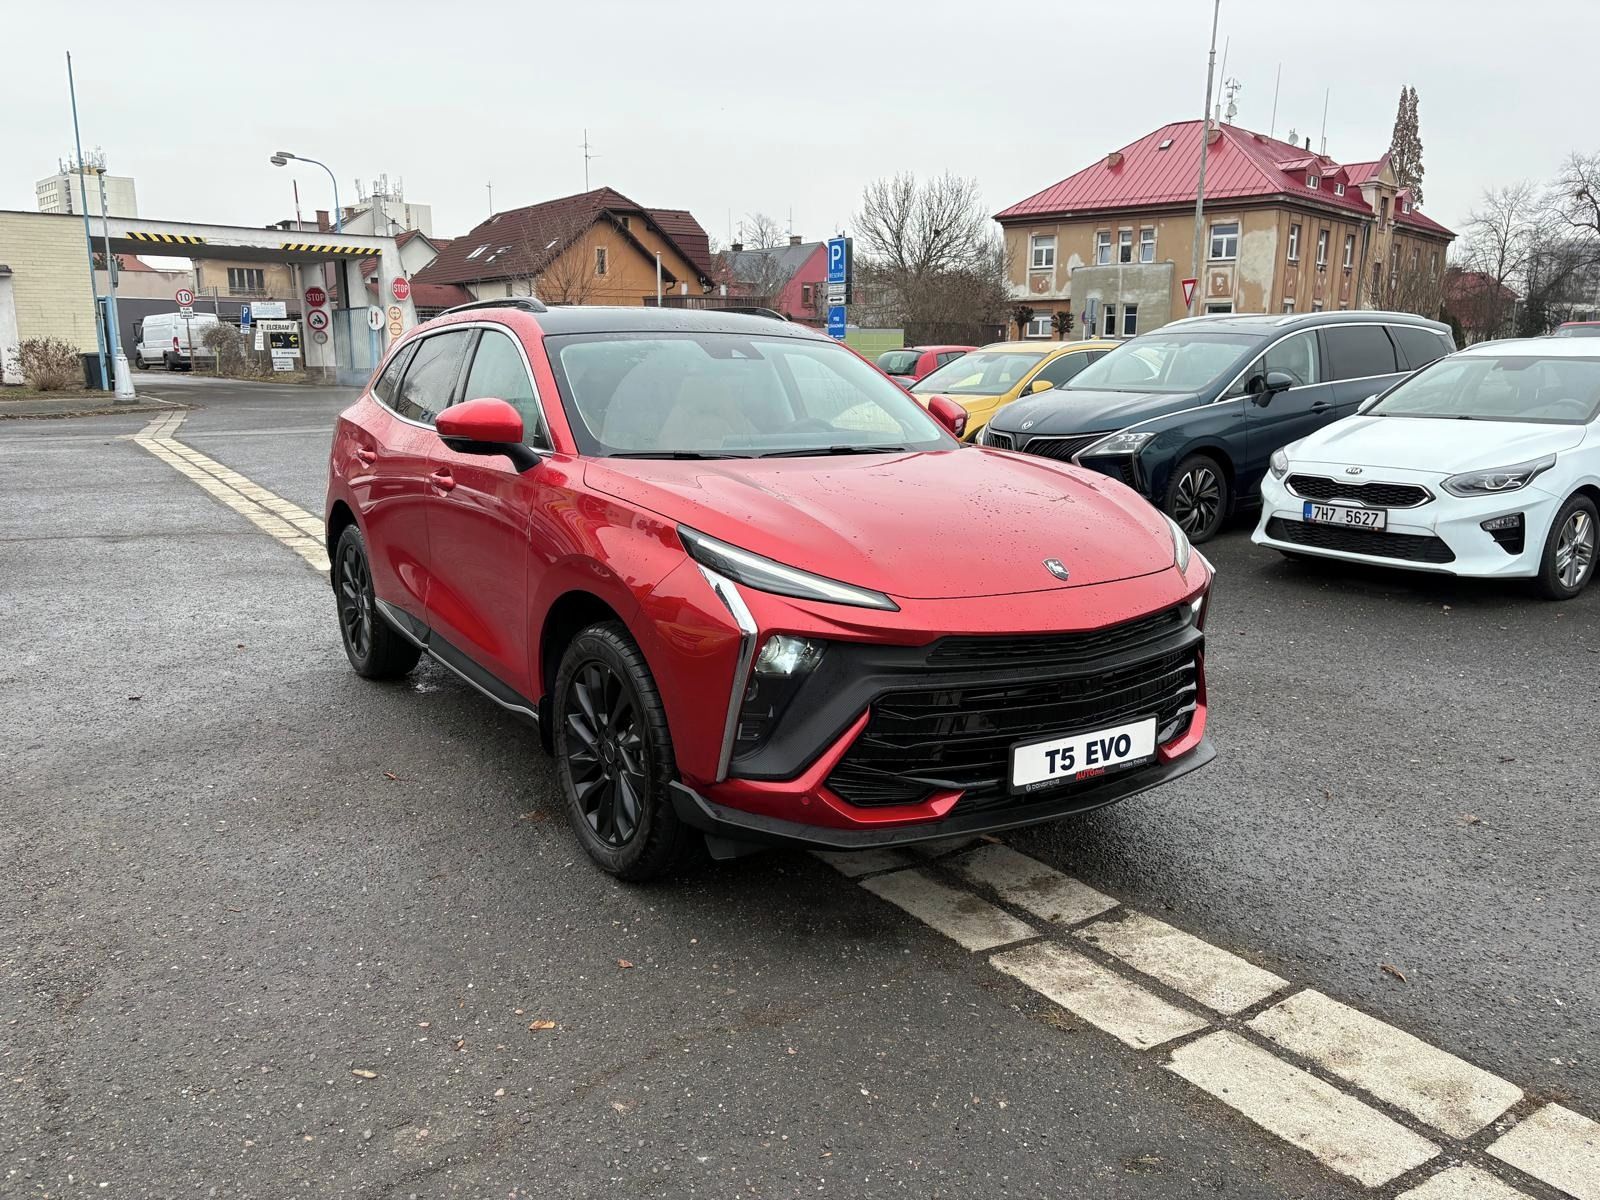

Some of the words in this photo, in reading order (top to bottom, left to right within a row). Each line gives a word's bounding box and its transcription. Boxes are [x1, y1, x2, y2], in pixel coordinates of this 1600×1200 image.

[831, 245, 842, 270] P
[393, 283, 408, 293] STOP
[179, 293, 190, 302] 10
[306, 293, 325, 302] STOP
[243, 307, 249, 318] P
[1314, 505, 1336, 521] 7H7
[1345, 510, 1379, 526] 5627
[1045, 746, 1076, 775] T5
[1086, 733, 1132, 765] EVO
